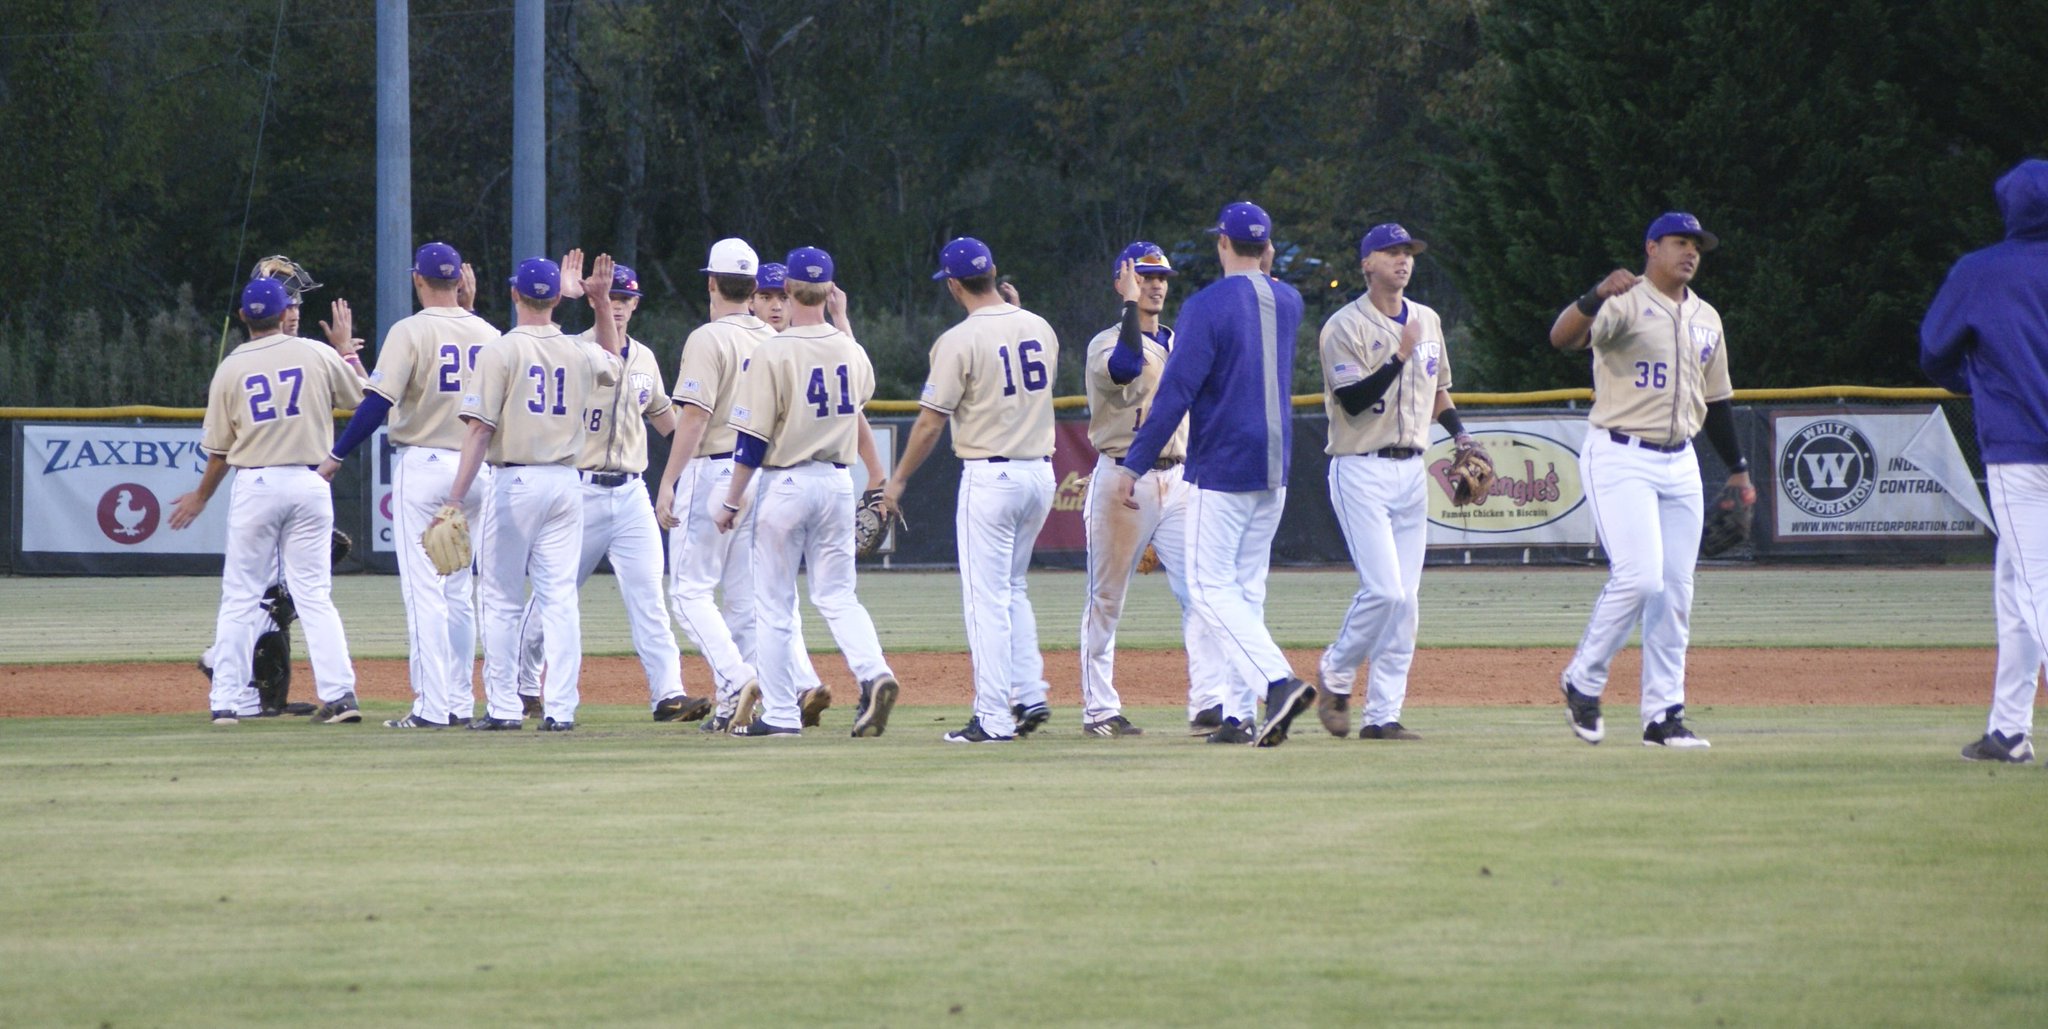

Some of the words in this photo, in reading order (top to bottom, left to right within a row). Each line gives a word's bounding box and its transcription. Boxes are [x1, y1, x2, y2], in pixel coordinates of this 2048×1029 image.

[998, 338, 1048, 397] 16
[1634, 360, 1668, 389] 36
[243, 366, 304, 423] 27
[527, 364, 567, 416] 31
[805, 363, 855, 418] 41
[1801, 422, 1854, 441] WHITE
[42, 439, 210, 476] ZAXBY'S
[1801, 452, 1857, 489] W
[1473, 509, 1504, 518] Chicken
[1516, 508, 1548, 518] Biscuits
[1786, 478, 1873, 514] CORPORATION
[1791, 520, 1975, 533] WWW.WNCWHITECORPORATION.COM
